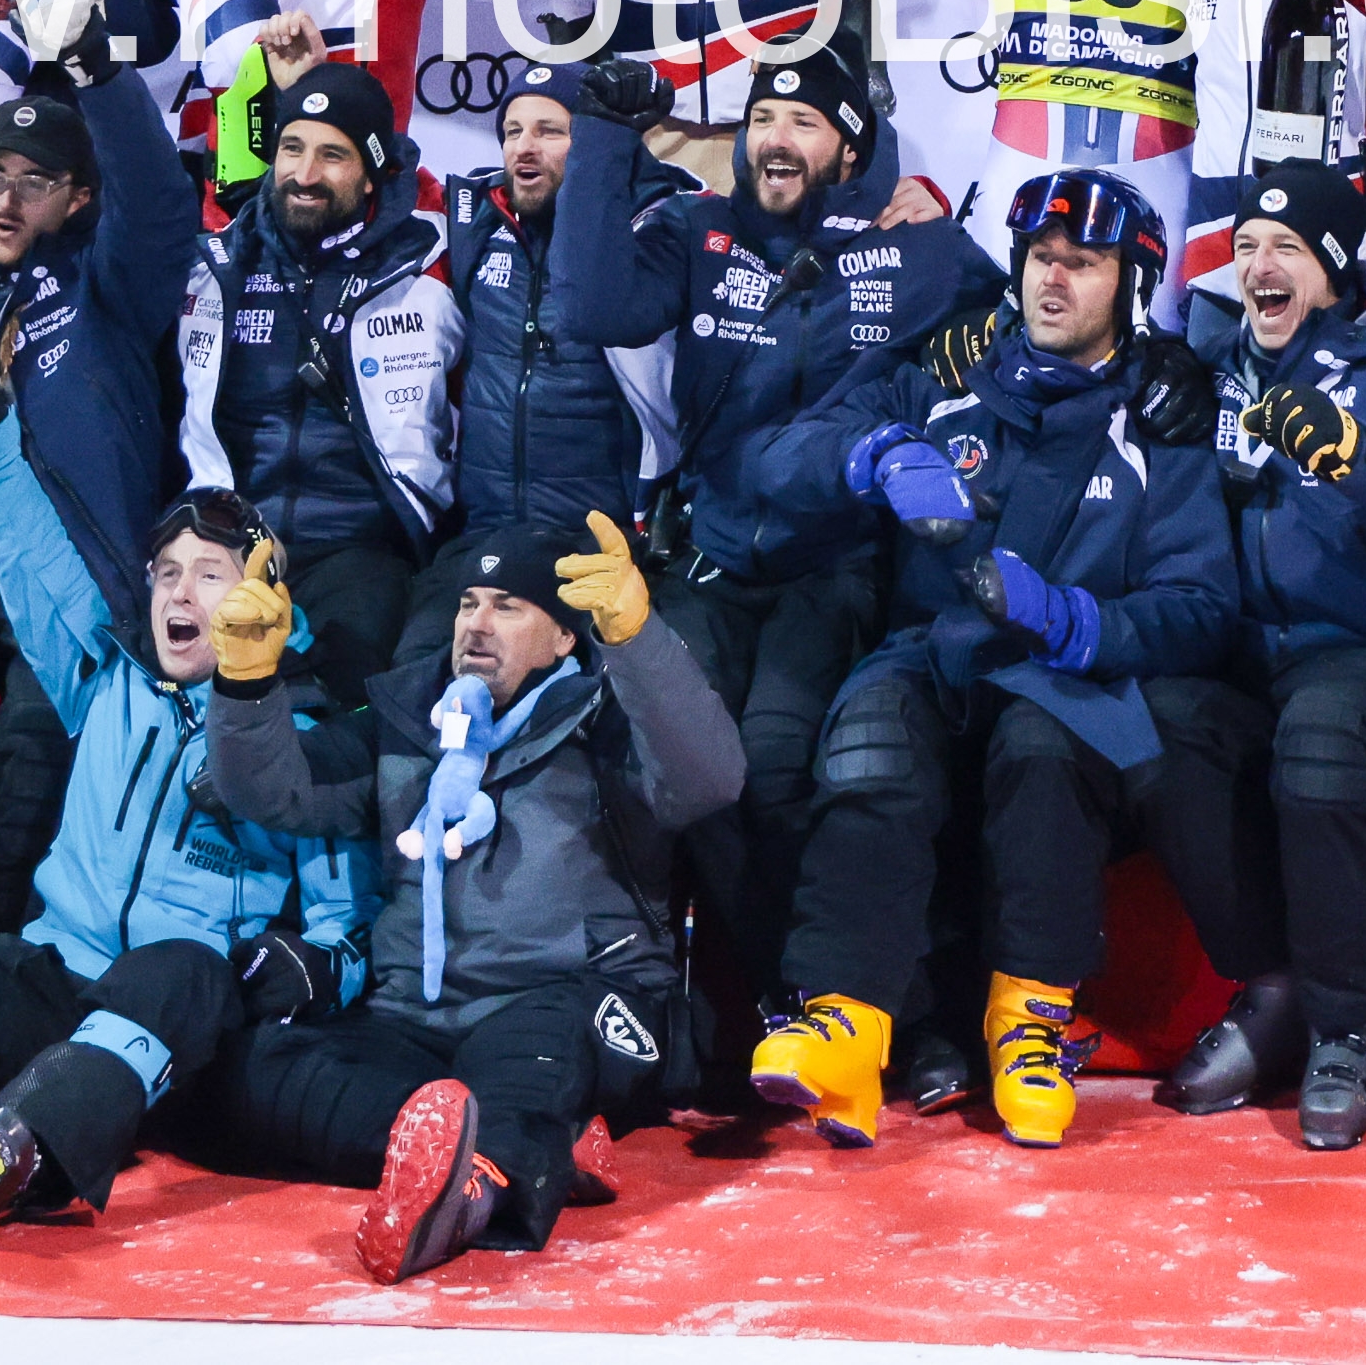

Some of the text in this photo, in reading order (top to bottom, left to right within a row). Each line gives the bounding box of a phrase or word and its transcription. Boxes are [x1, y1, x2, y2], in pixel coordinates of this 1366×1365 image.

[1030, 22, 1144, 47] MADONNA
[1028, 38, 1165, 71] DI CAMPIGLIO
[1049, 73, 1115, 93] ZGONC
[1327, 6, 1349, 166] FERRARI
[249, 103, 262, 149] LEKI
[841, 106, 862, 133] COLMAR
[1256, 129, 1304, 144] FERRARI
[458, 189, 472, 224] COLMAR
[208, 237, 229, 265] COLMAR
[487, 252, 513, 271] GREEN
[732, 243, 766, 265] CAISSE
[838, 246, 902, 277] COLMAR
[1325, 237, 1344, 264] COLMAR
[485, 269, 511, 289] WEEZ
[725, 266, 770, 292] GREEN
[730, 249, 784, 284] D'EPARGNE
[729, 285, 766, 312] WEEZ
[850, 281, 893, 291] SAVOIE
[850, 291, 885, 302] MONT
[25, 304, 72, 333] Auvergne-
[235, 310, 274, 327] GREEN
[850, 302, 893, 313] BLANC
[190, 329, 216, 348] GREEN
[238, 326, 273, 344] WEEZ
[367, 312, 424, 339] COLMAR
[383, 351, 431, 363] Auvergne-
[383, 359, 442, 374] Rhône-Alpes
[1142, 383, 1170, 418] reusch
[191, 837, 240, 864] WORLD
[184, 850, 237, 879] REBELS
[242, 947, 269, 980] reusch
[613, 1000, 652, 1052] ROSSIGNOL
